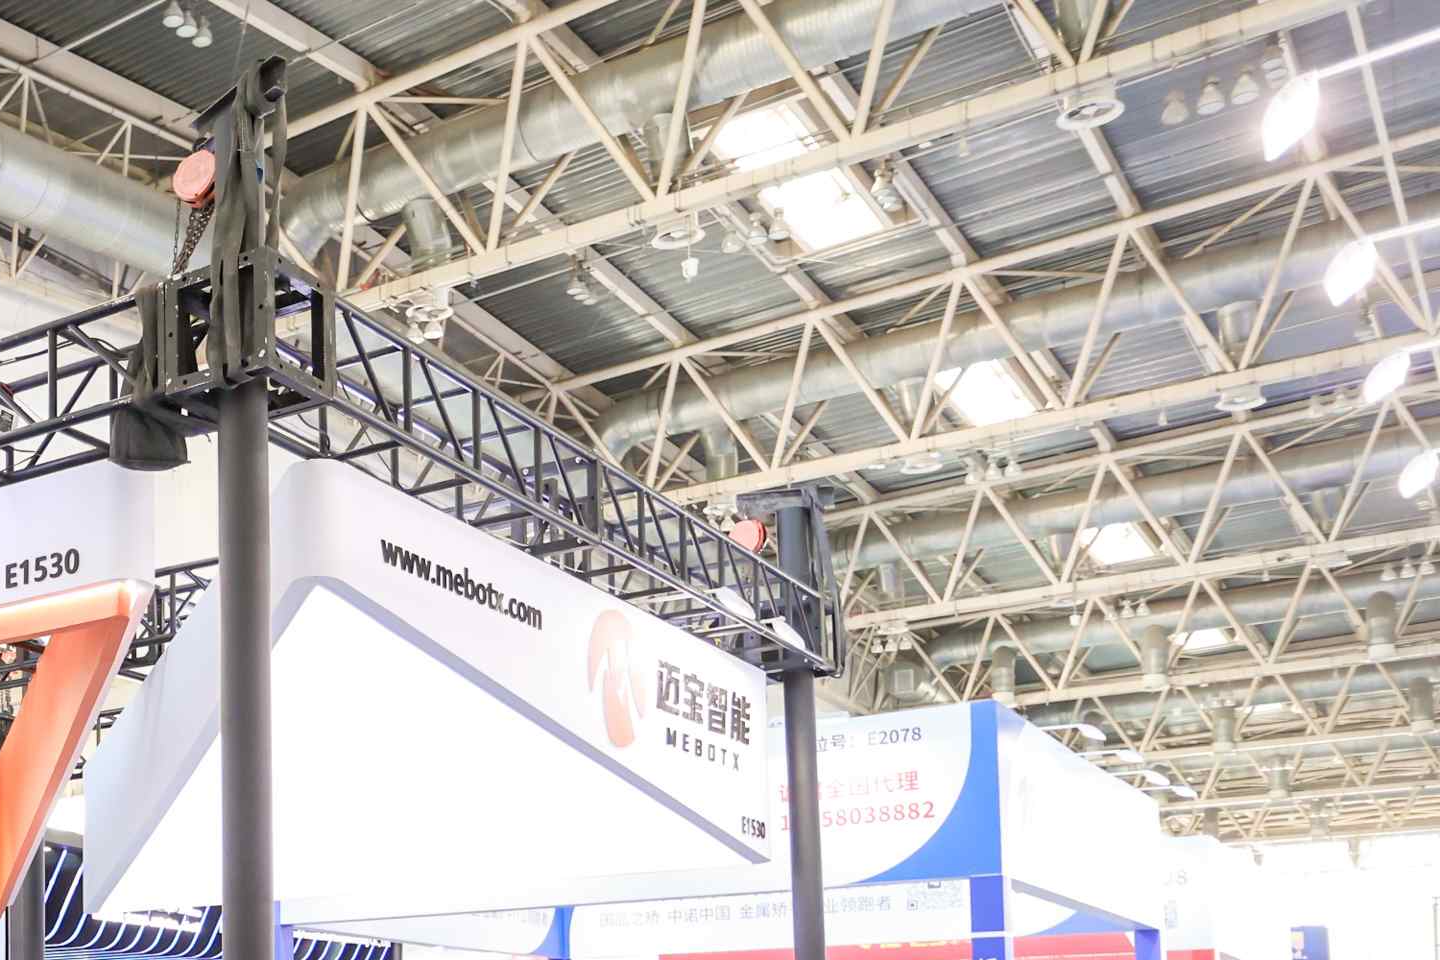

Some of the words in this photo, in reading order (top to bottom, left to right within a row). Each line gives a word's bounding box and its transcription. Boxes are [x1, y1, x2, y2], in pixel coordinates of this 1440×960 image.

[4, 548, 80, 590] E1530
[380, 537, 543, 631] www.mebotx.com
[656, 658, 751, 746] 迈宝智能
[665, 726, 741, 772] MEBOTX
[867, 726, 923, 747] E2078
[741, 815, 768, 841] E1530
